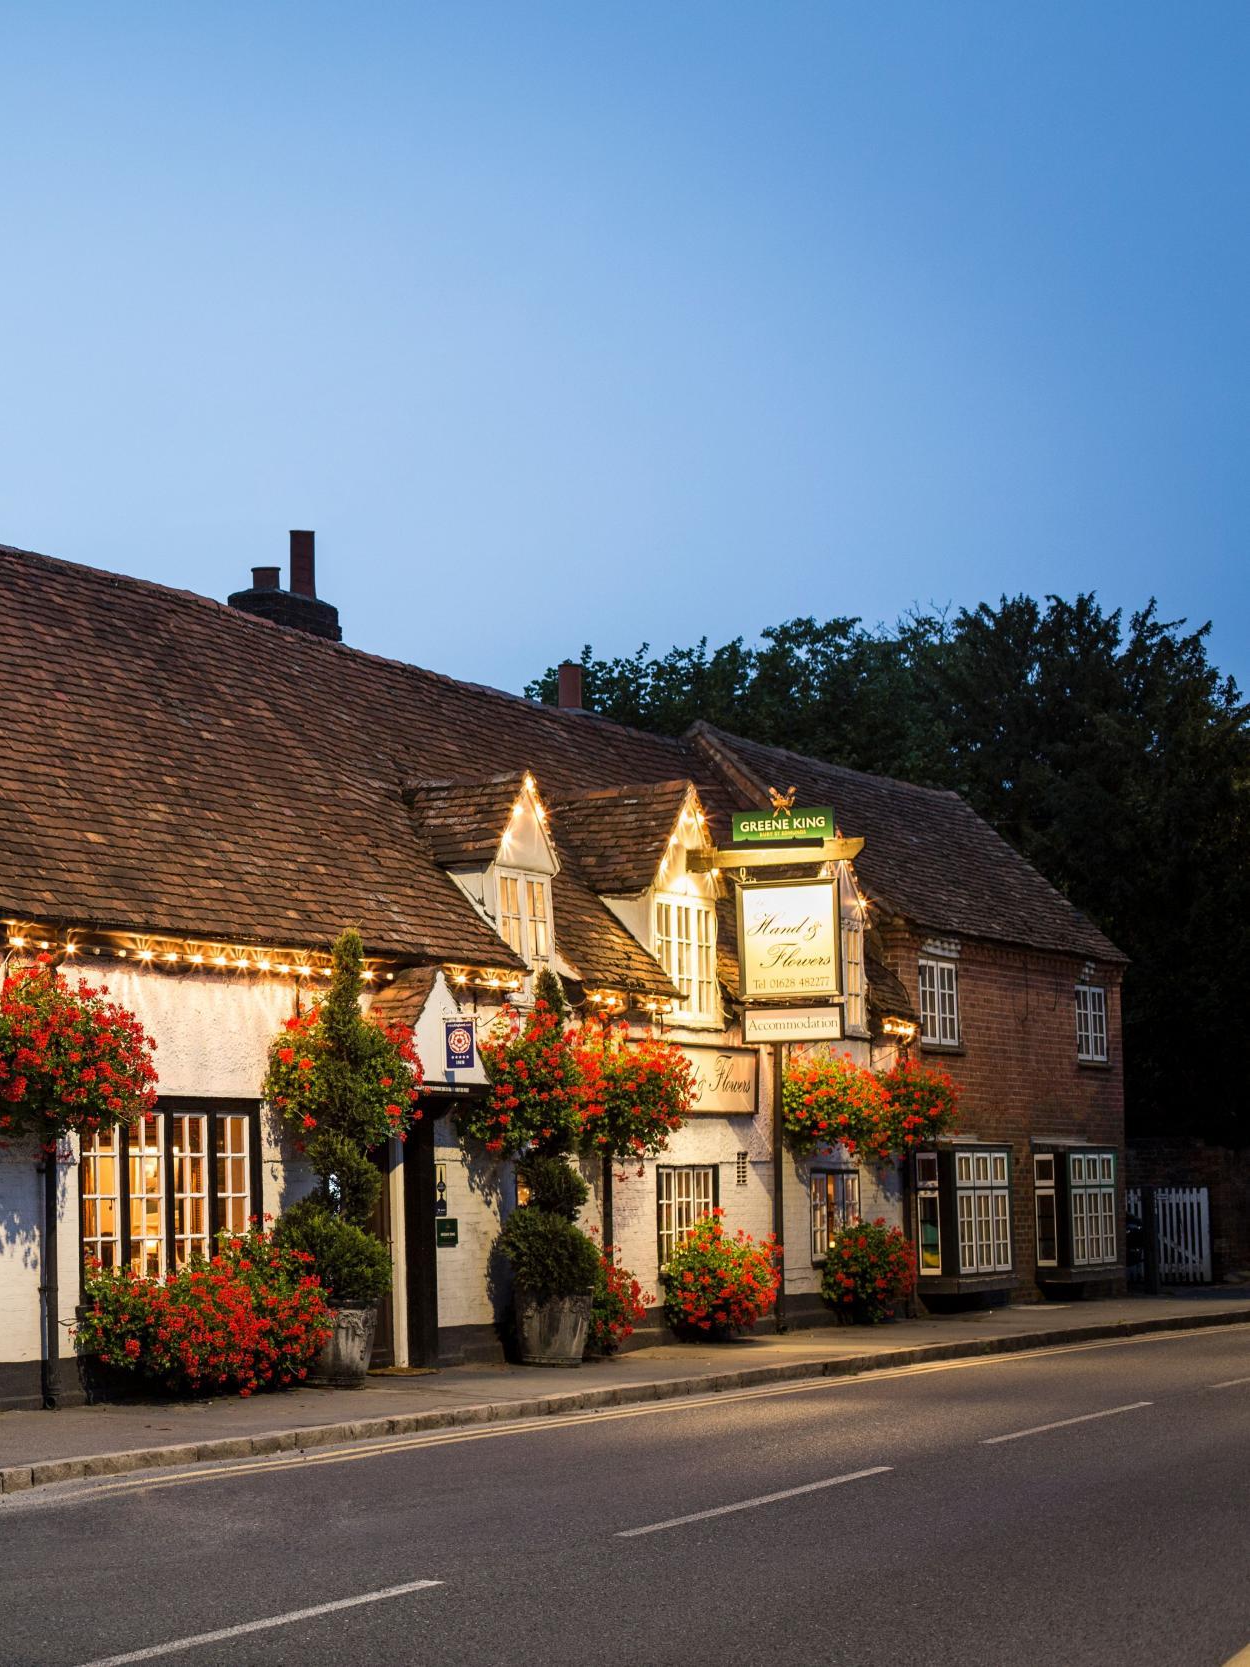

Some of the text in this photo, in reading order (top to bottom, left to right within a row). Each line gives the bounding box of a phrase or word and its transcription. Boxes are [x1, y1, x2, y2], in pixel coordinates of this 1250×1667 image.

[740, 816, 825, 833] GREENE KING
[747, 912, 822, 942] Hand &
[759, 943, 831, 969] Flowers
[753, 976, 830, 990] Tel 01628 482277
[748, 1016, 838, 1032] Accommodation
[709, 1054, 751, 1093] Flowers
